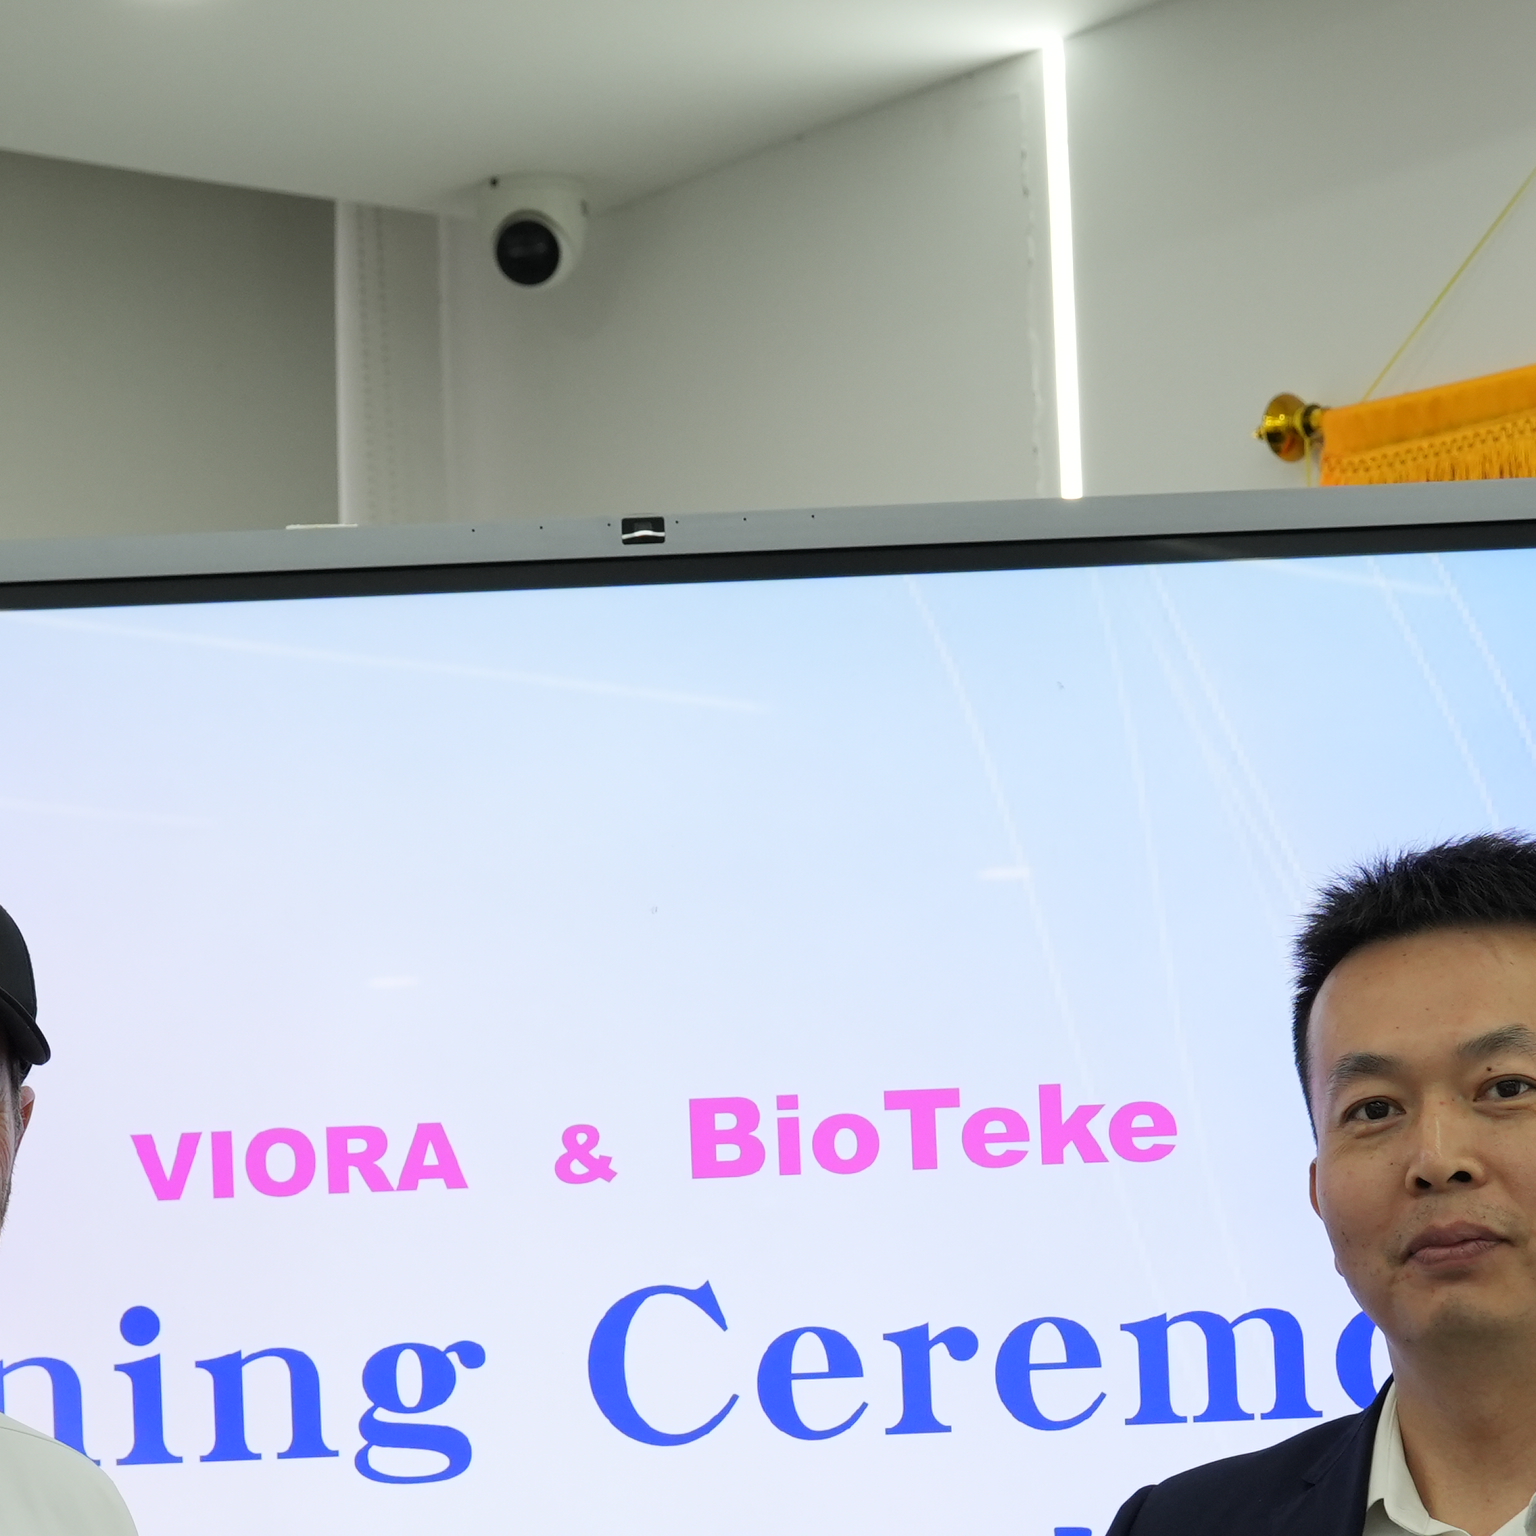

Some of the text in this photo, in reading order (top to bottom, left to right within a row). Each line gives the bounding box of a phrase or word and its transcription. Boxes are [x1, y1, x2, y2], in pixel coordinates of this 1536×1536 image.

[130, 1084, 1178, 1201] VIORA & BioTeke
